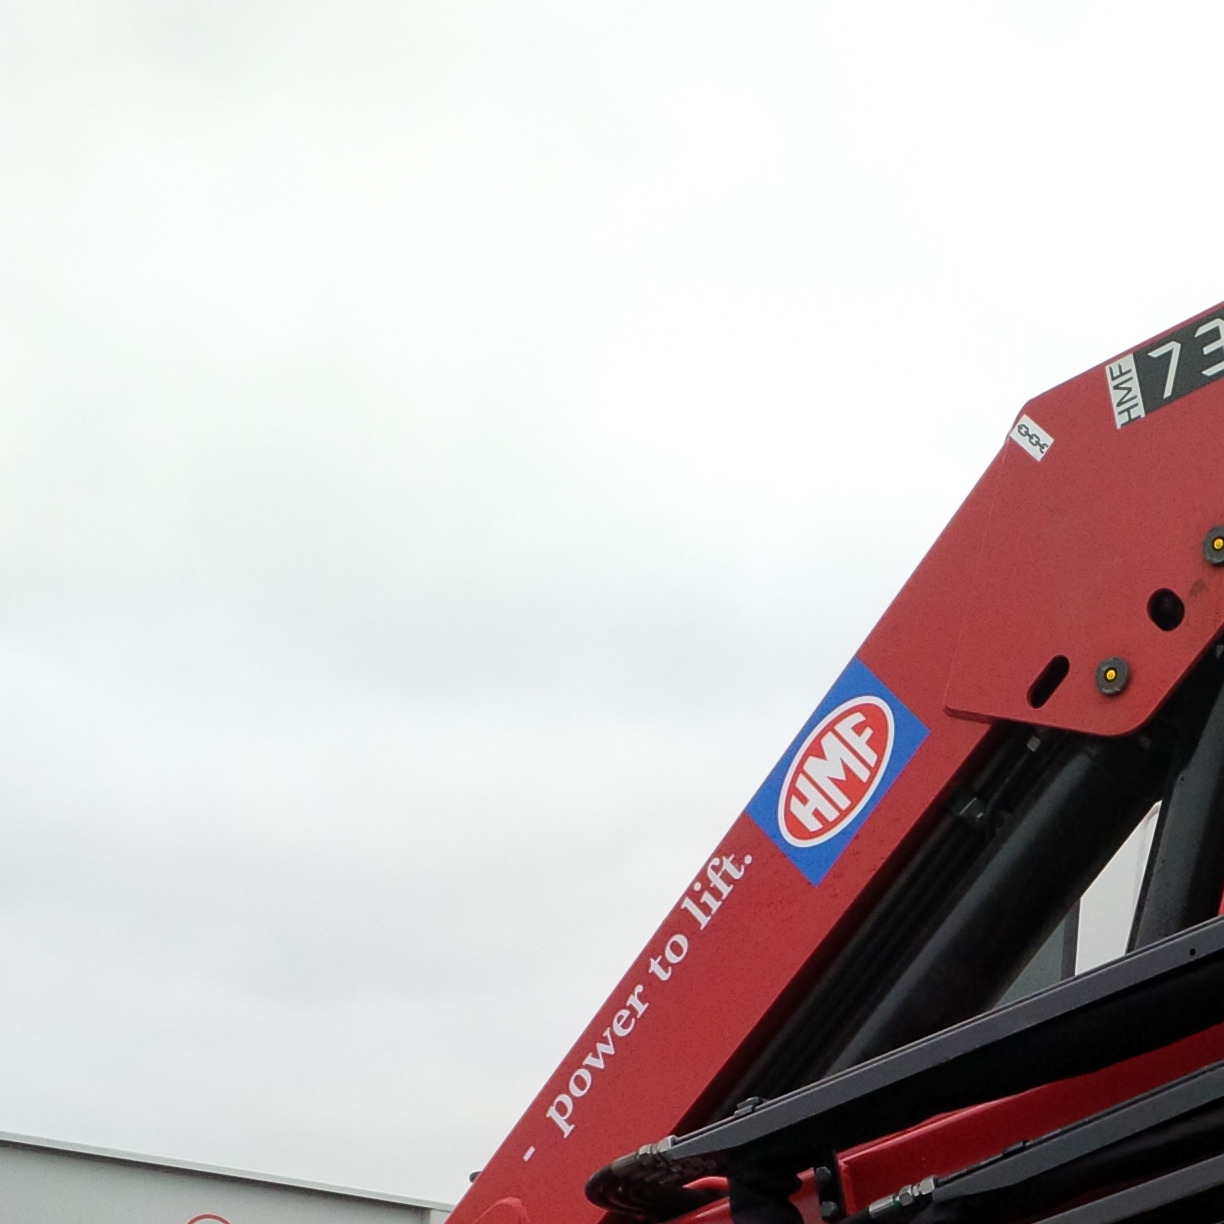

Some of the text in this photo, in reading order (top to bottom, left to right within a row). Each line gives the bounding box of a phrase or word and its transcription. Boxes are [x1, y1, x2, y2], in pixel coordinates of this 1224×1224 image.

[1108, 363, 1142, 428] HMF
[790, 710, 879, 832] HMF
[545, 983, 651, 1139] power
[648, 932, 690, 983] to
[680, 850, 753, 931] lift.
